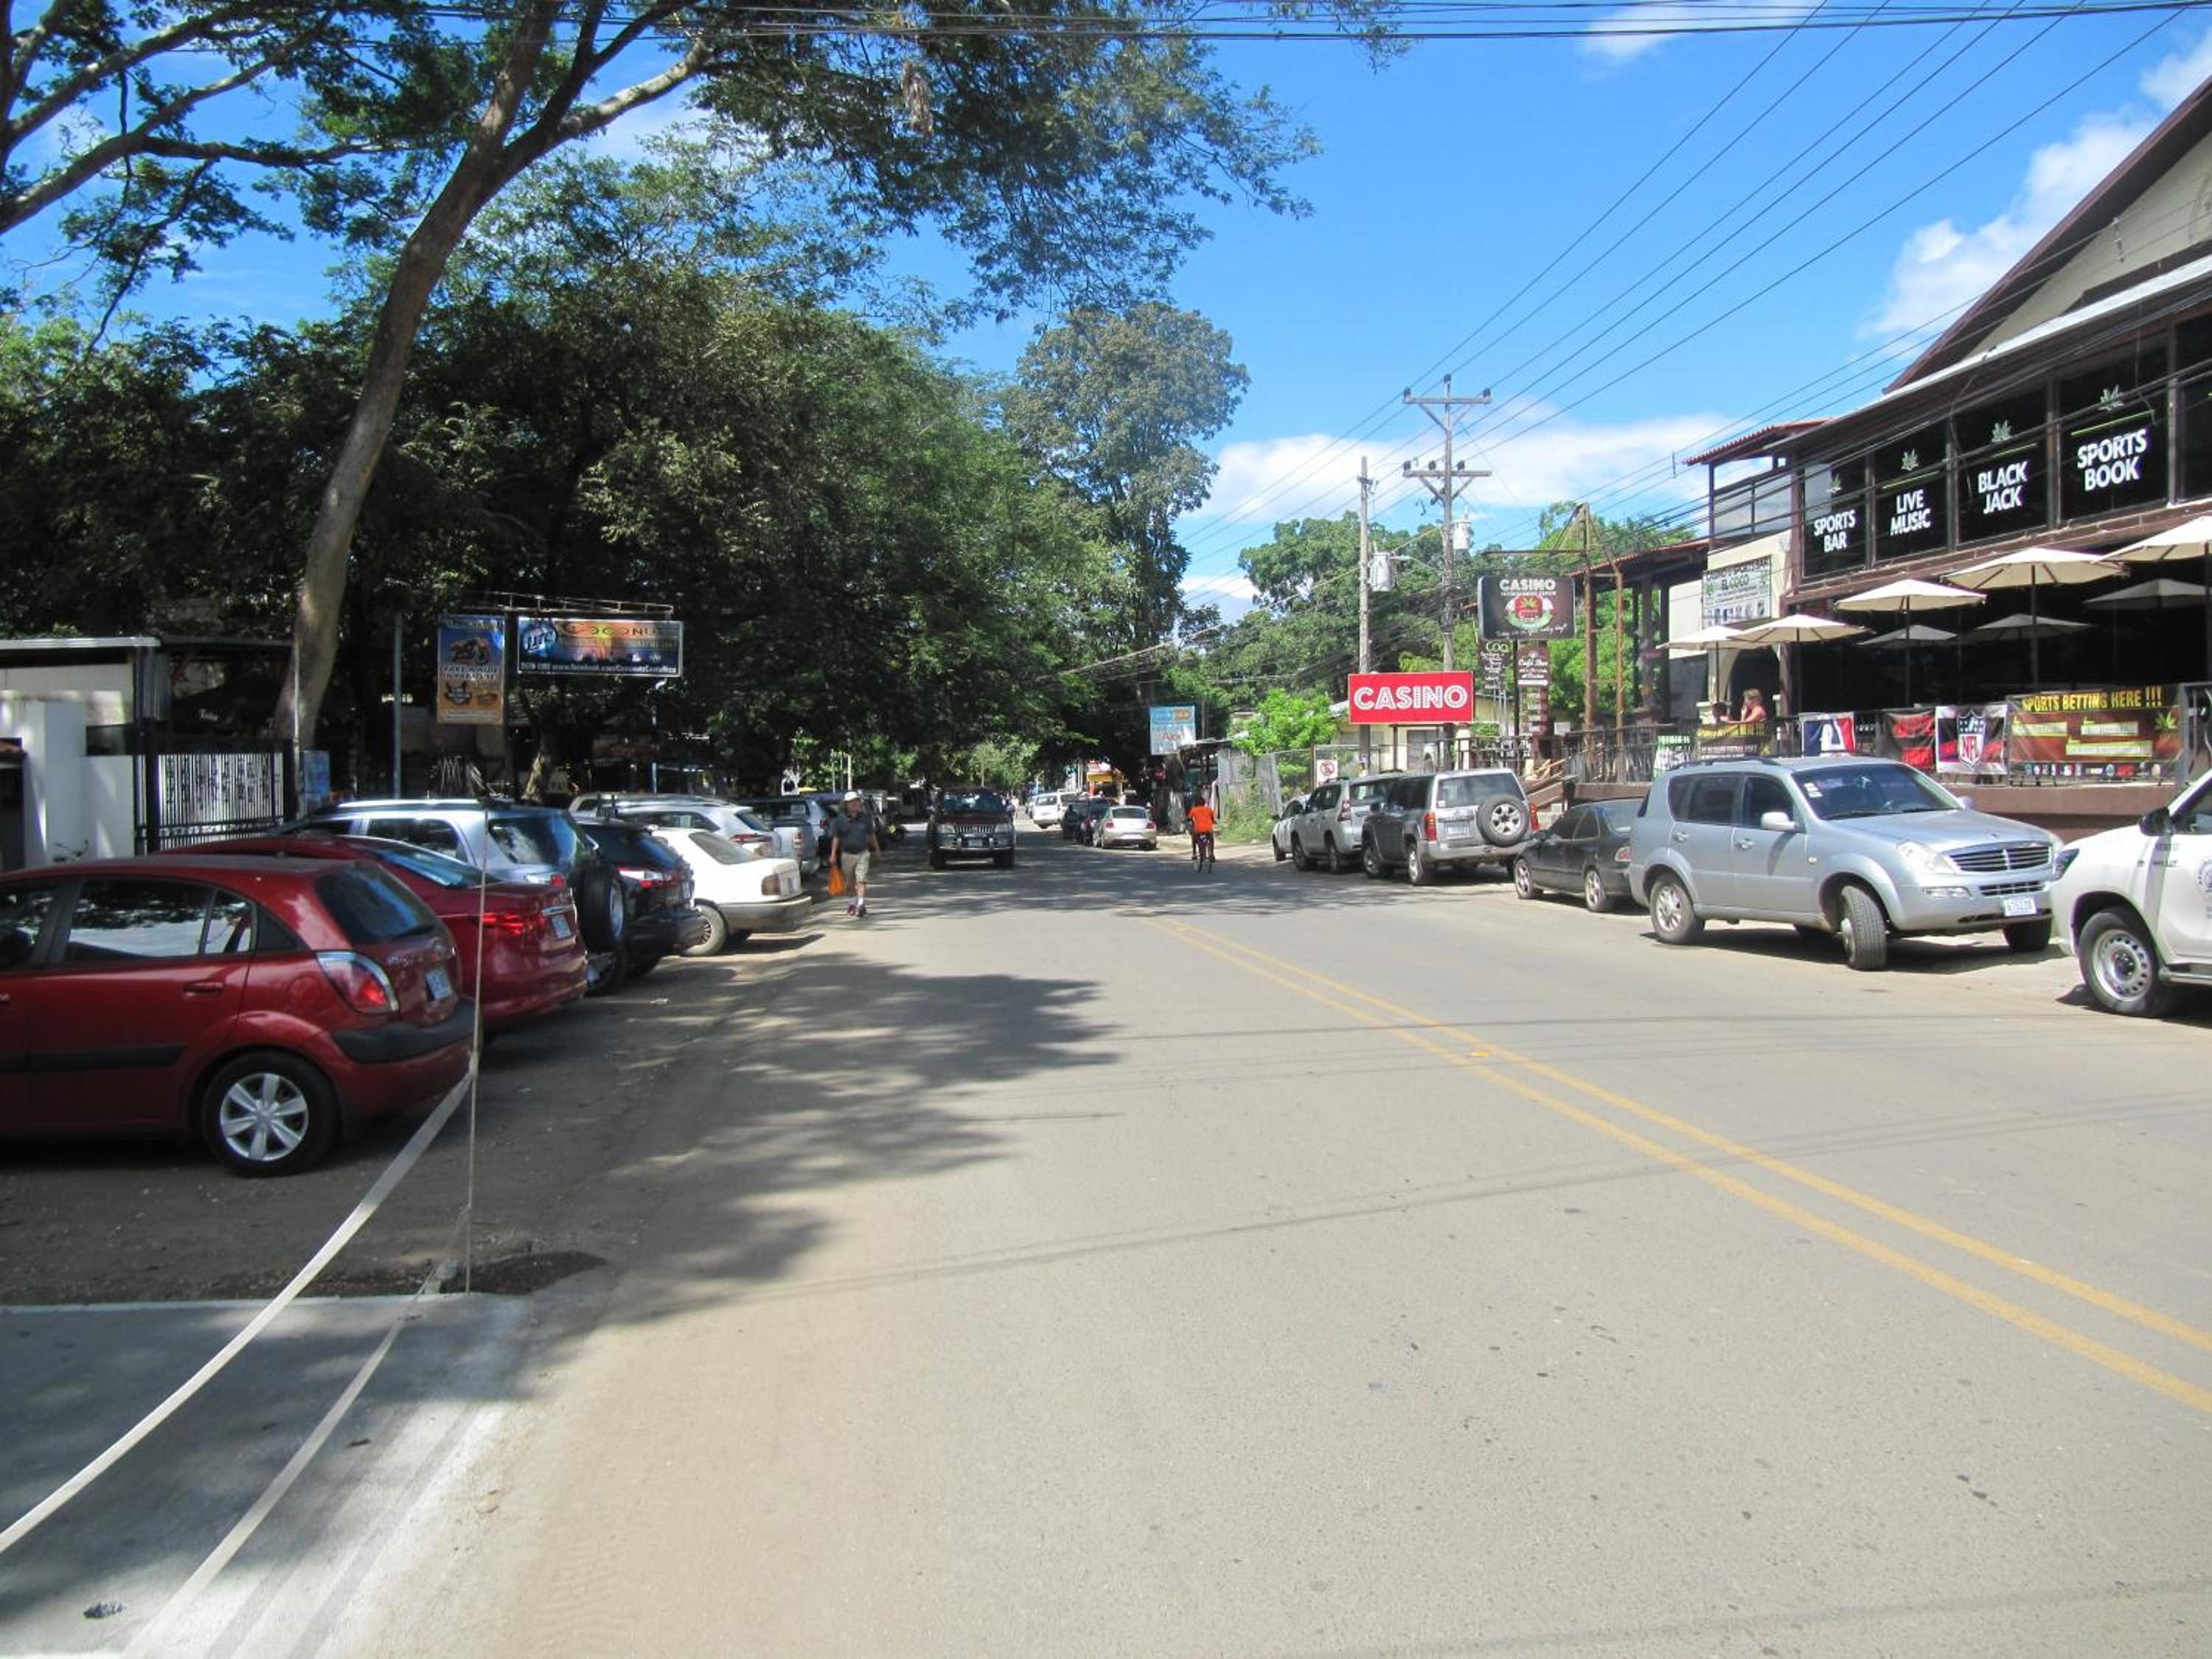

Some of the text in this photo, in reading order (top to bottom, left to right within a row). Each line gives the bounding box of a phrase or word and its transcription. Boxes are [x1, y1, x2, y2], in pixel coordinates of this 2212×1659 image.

[2076, 428, 2148, 468] SPORTS
[1978, 460, 2028, 493] BLACK
[2084, 456, 2140, 492] BOOK
[1896, 489, 1924, 514] LIVE
[1983, 485, 2023, 515] JACK
[1813, 509, 1856, 536] SPORTS
[1890, 508, 1932, 536] MUSIC
[1823, 532, 1848, 553] BAR
[1499, 578, 1557, 591] CASINO
[1729, 574, 1750, 588] COCO
[1354, 685, 1468, 710] CASINO
[2022, 686, 2163, 712] SPORTS BETTING HERE !!!
[1962, 735, 1980, 759] NFL
